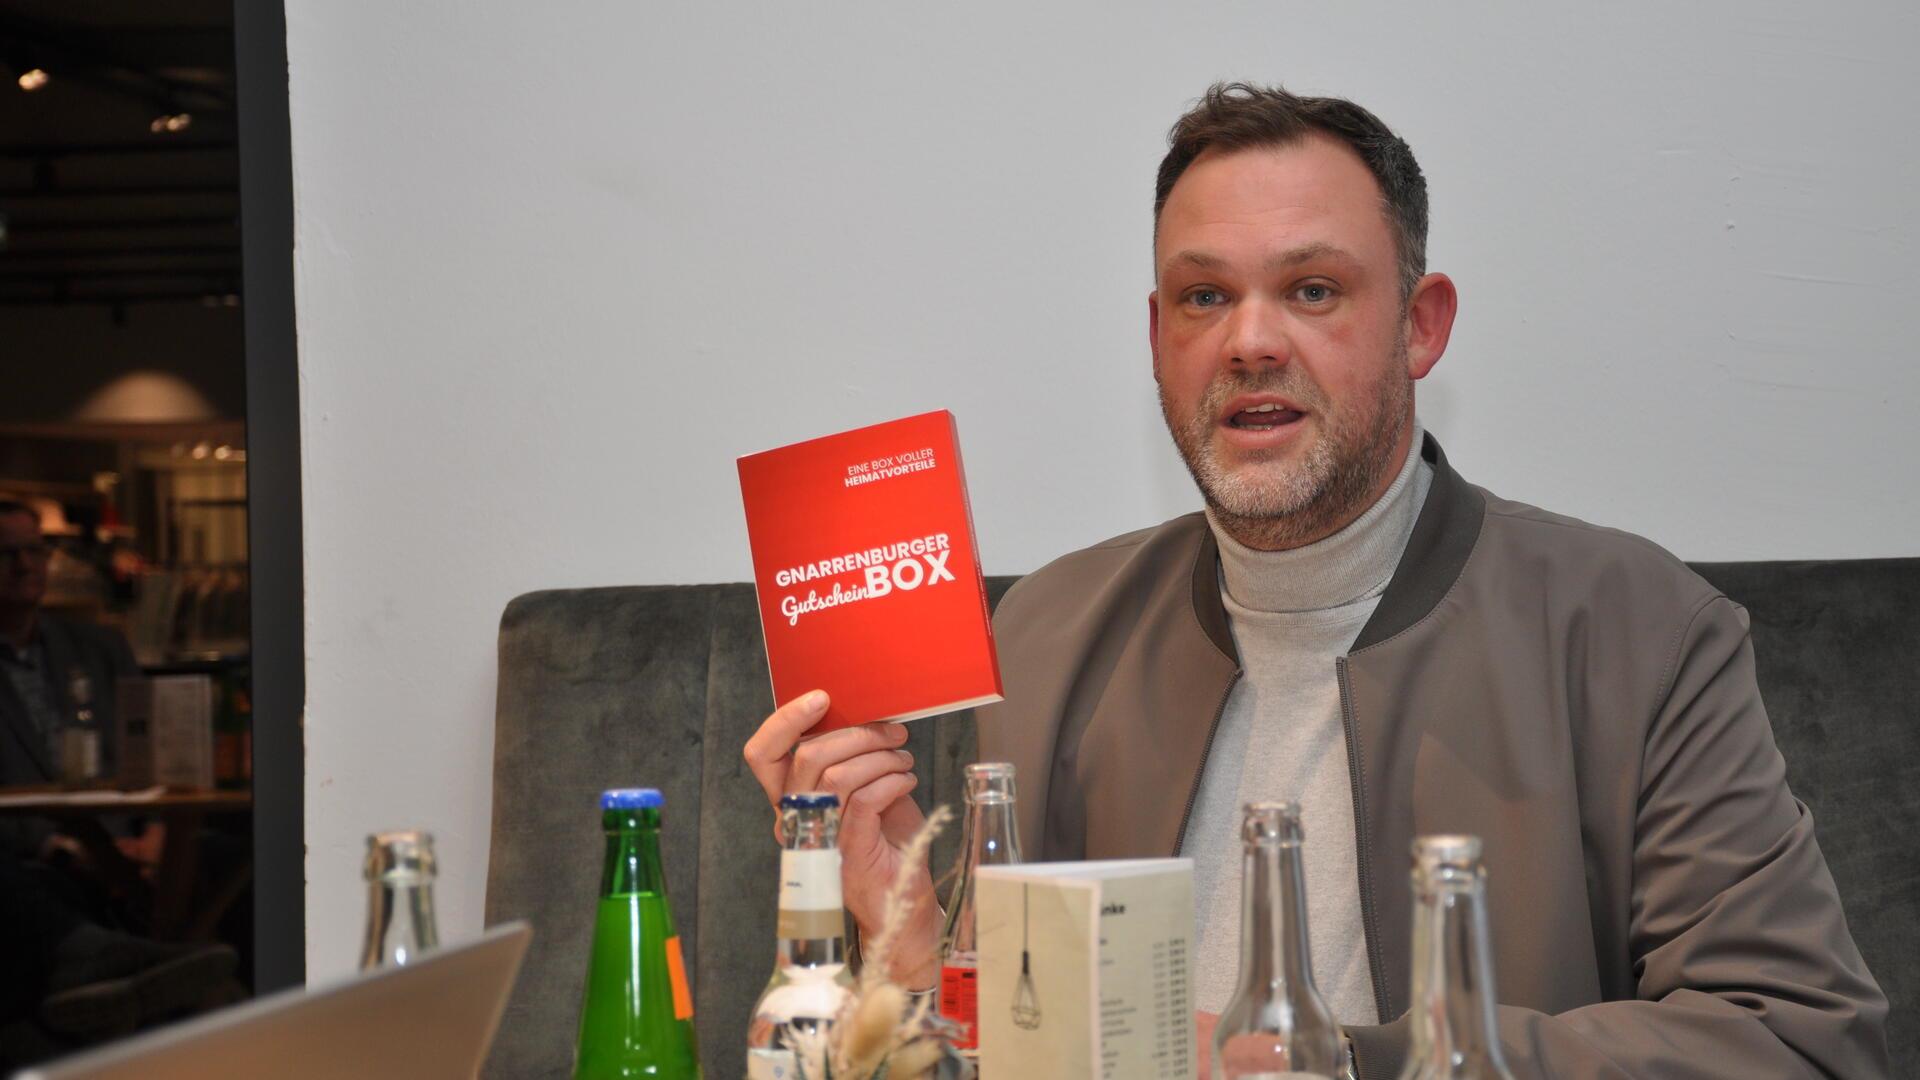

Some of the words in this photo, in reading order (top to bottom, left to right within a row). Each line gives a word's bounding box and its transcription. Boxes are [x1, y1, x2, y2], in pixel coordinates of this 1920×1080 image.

[844, 458, 936, 487] HEIMATVORTEILE
[848, 463, 869, 475] EINE
[871, 457, 893, 470] BOX
[895, 448, 933, 464] VOLLER
[775, 533, 950, 587] GNARRENBURGER
